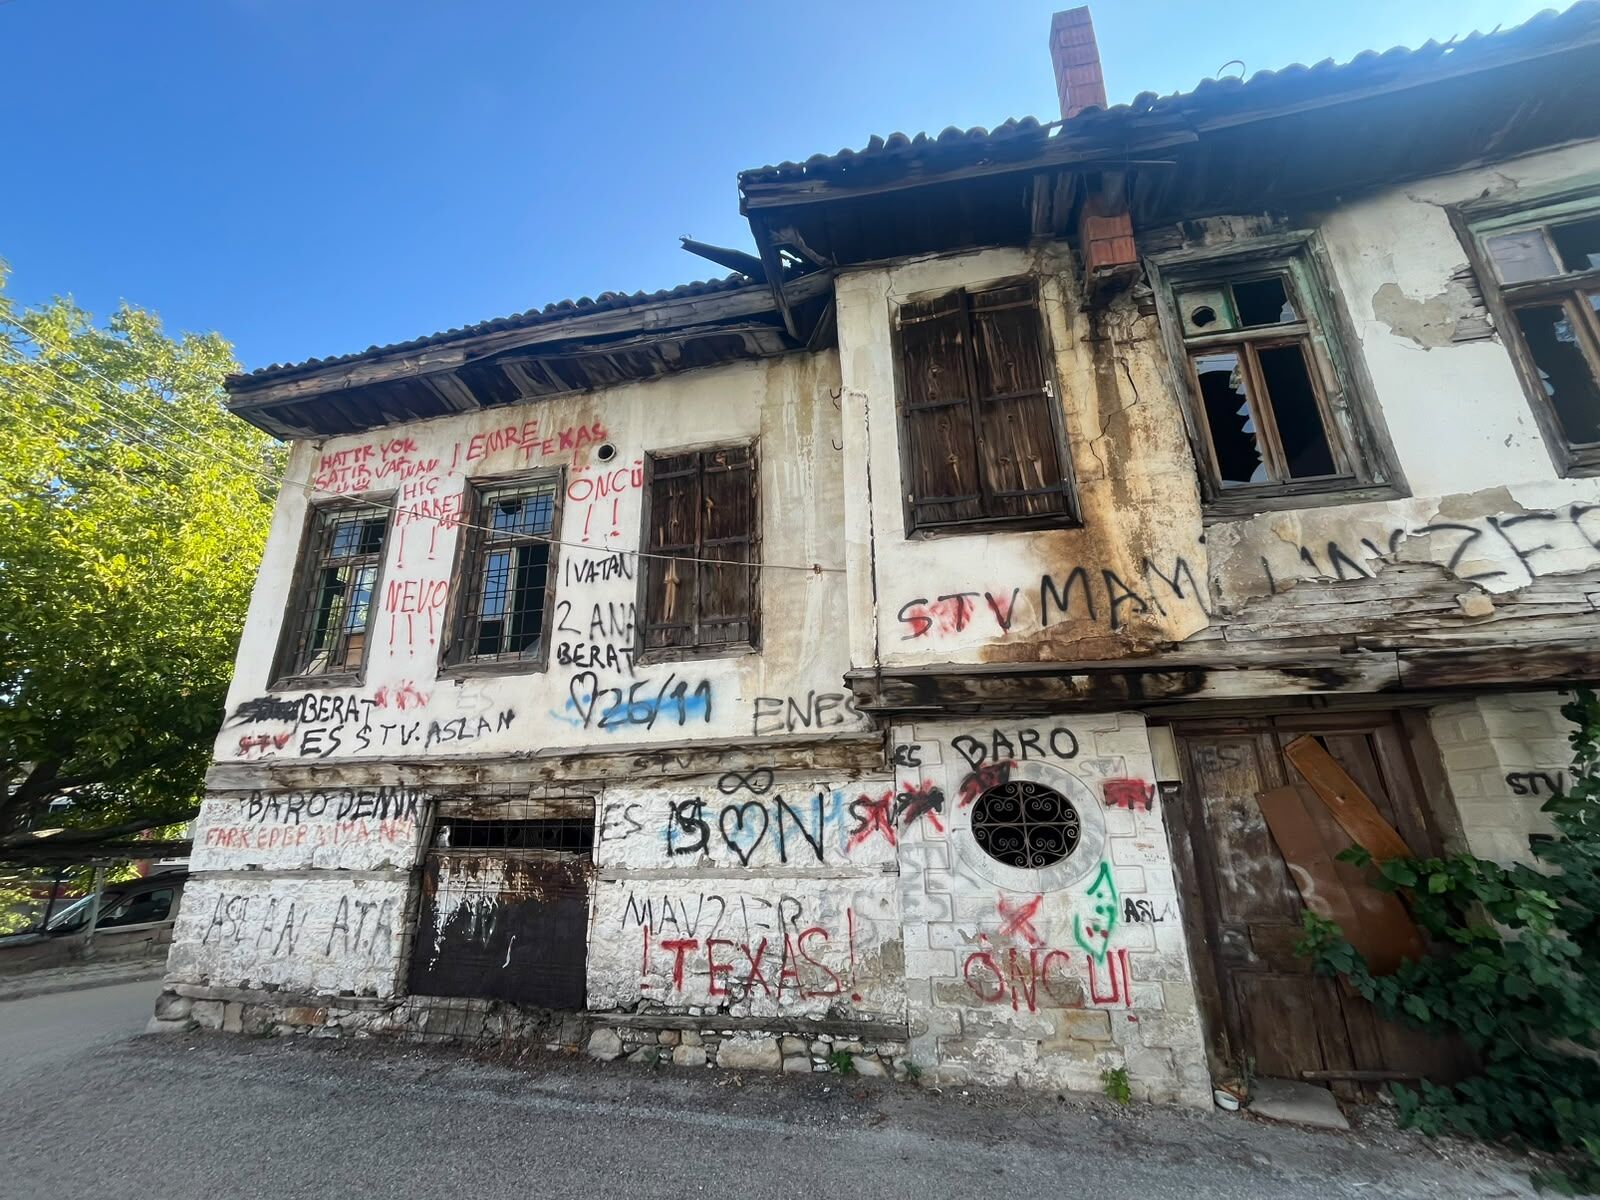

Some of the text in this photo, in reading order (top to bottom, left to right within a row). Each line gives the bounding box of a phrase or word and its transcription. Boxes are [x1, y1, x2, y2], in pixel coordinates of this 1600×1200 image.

[379, 438, 418, 462] YOK
[574, 552, 632, 584] VATAN
[385, 578, 449, 614] NEVO
[556, 600, 581, 635] 2
[897, 588, 1019, 641] STV
[556, 641, 636, 678] BERAT
[301, 692, 378, 730] BERAT
[300, 724, 344, 759] ES
[1506, 771, 1564, 797] STV
[247, 789, 334, 826] BARO
